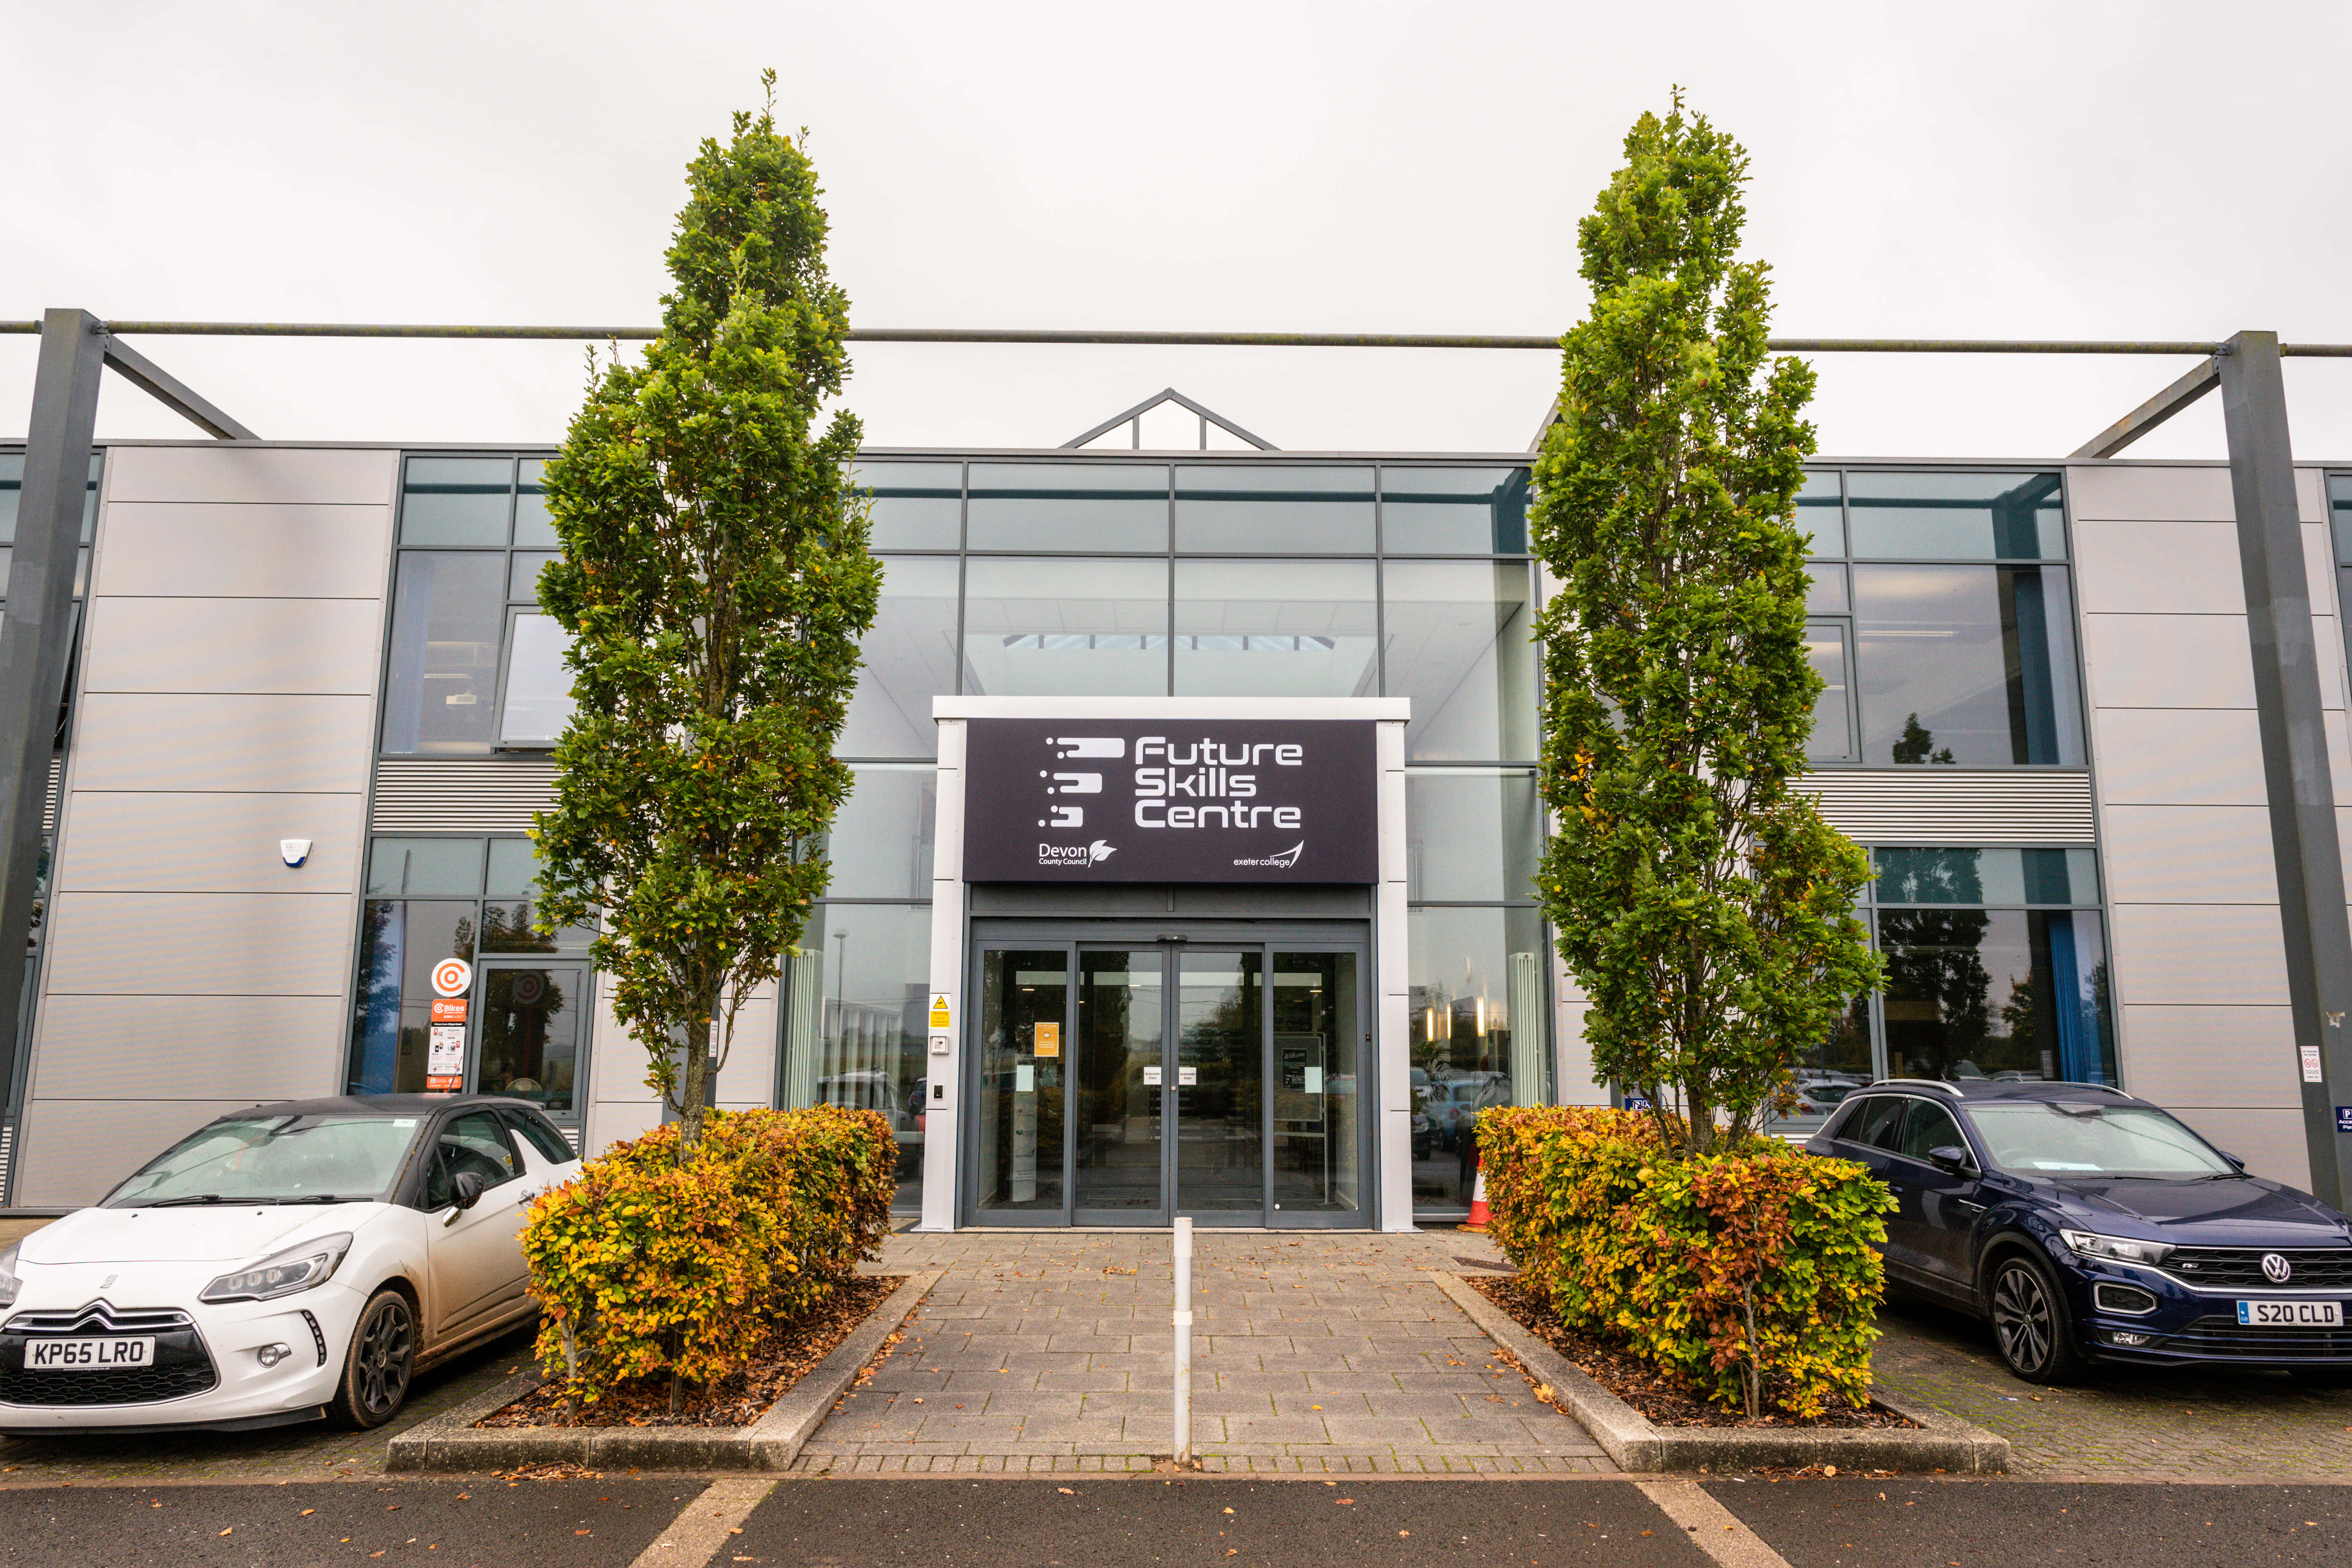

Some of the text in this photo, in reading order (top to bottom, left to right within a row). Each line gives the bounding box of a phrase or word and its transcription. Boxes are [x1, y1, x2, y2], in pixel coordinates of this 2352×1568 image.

[1135, 737, 1303, 766] Future
[1135, 767, 1256, 797] Skills
[1135, 799, 1301, 828] Centre
[1039, 843, 1087, 857] Devon
[1260, 857, 1290, 868] college
[2257, 1305, 2334, 1322] S20 CLD
[34, 1341, 143, 1364] KP65 LRO
